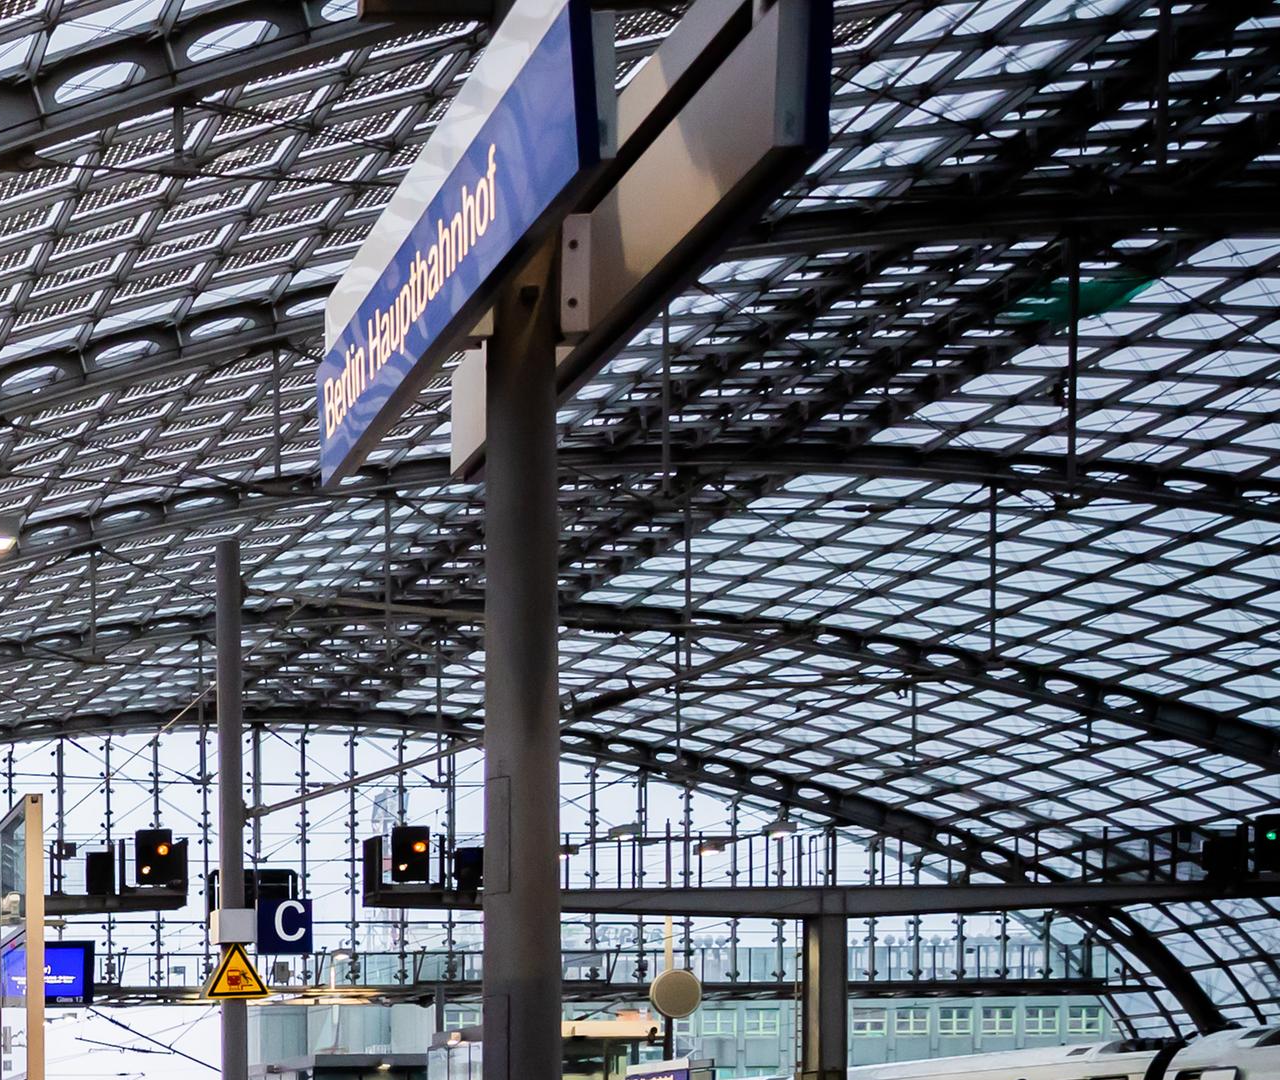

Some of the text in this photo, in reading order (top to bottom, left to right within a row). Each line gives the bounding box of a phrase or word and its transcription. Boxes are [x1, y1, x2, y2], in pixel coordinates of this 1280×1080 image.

[323, 143, 497, 440] Berlin Hauptbahnhof
[275, 900, 306, 941] C
